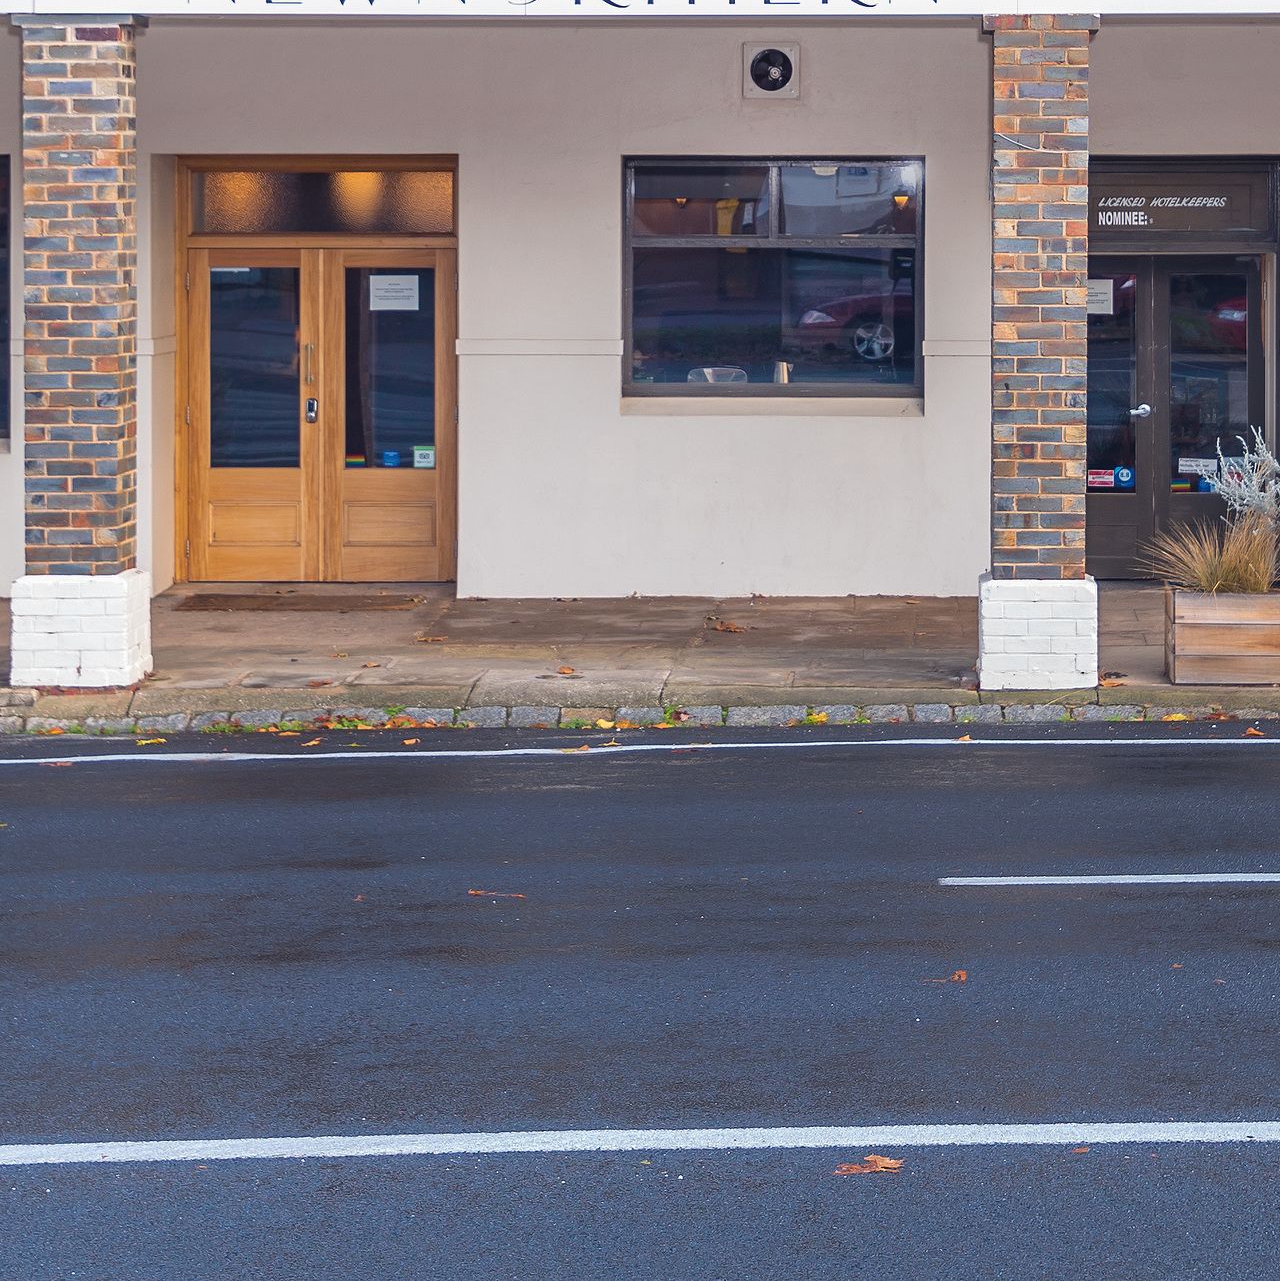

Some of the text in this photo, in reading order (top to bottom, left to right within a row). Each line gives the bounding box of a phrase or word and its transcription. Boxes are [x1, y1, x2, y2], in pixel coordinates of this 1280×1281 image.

[1098, 197, 1227, 207] LICENSED HOTELKEEPERS
[1098, 211, 1148, 226] NOMINEE:
